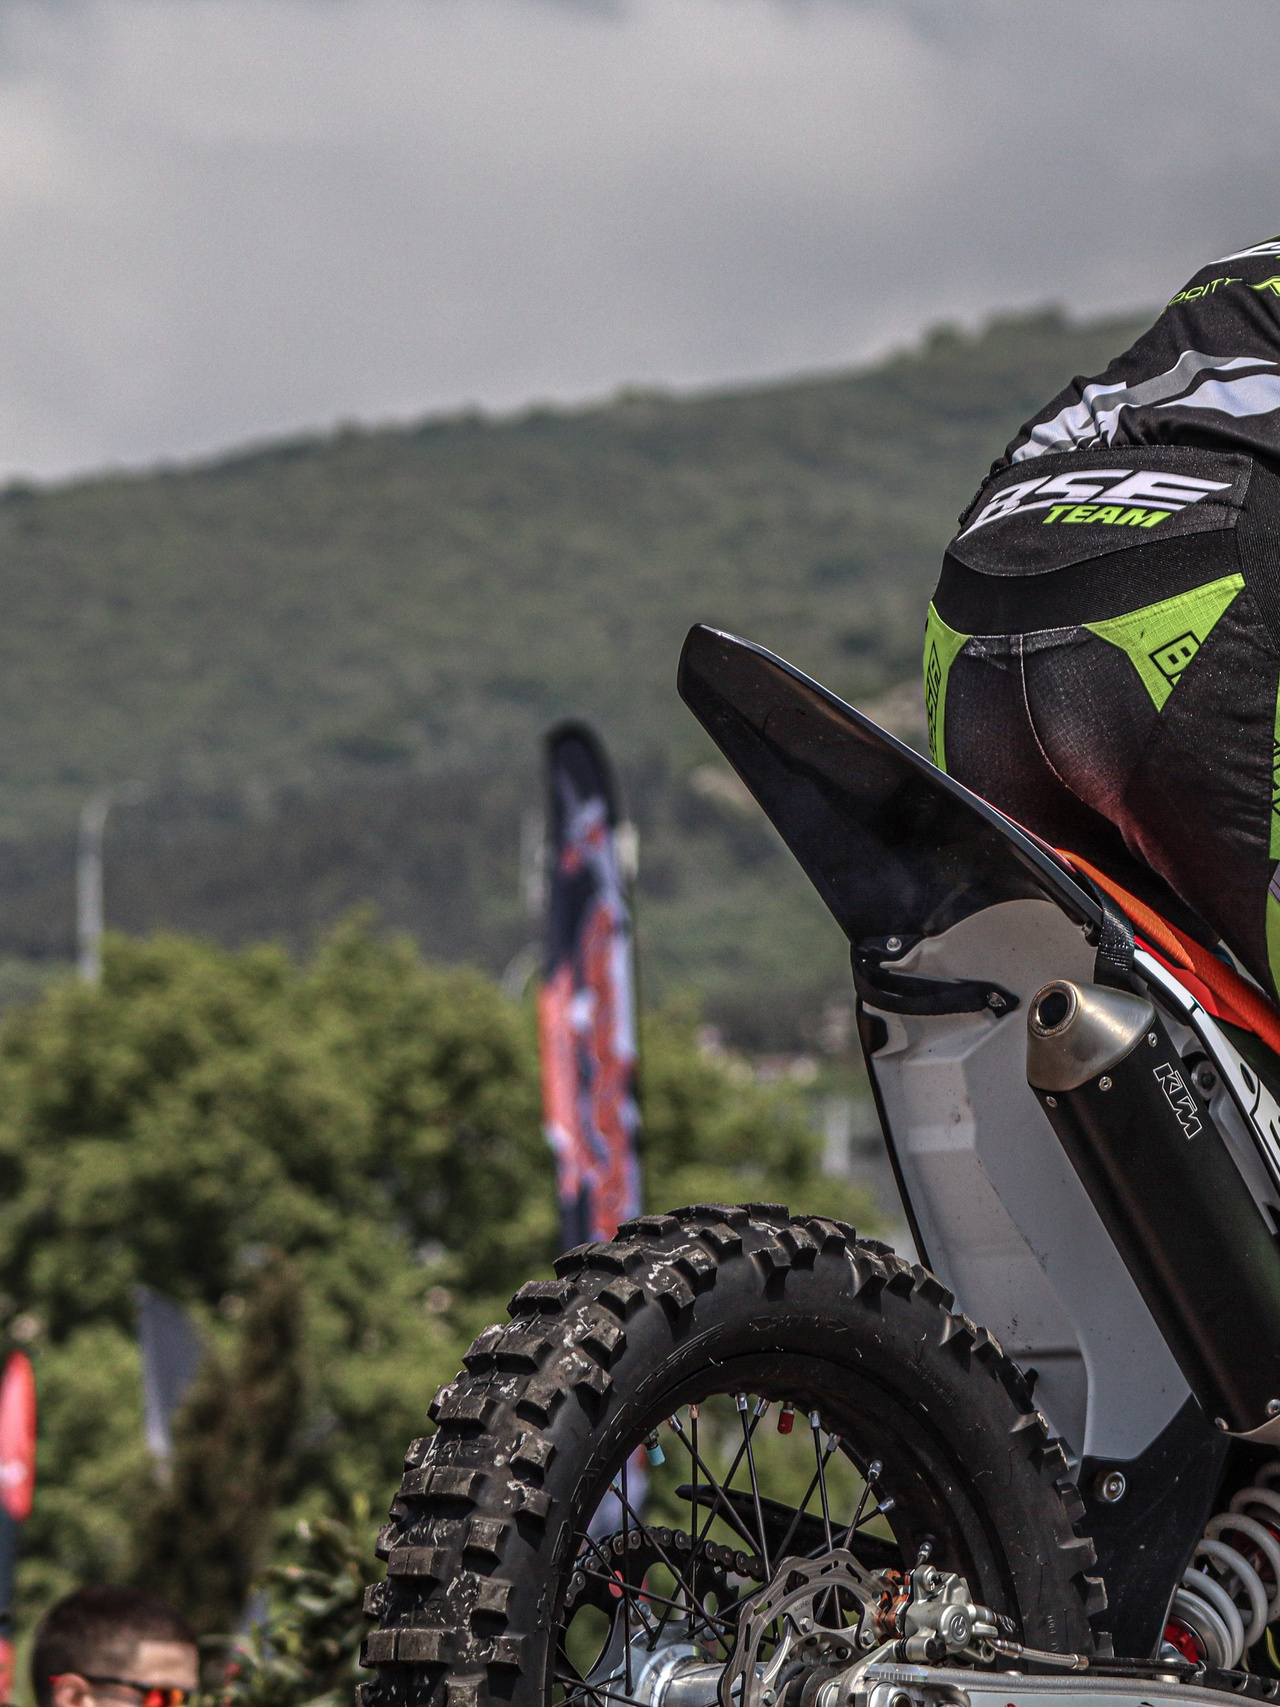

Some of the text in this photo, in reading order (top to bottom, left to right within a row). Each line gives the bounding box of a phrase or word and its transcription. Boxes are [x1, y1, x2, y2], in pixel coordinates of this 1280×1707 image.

[1160, 277, 1244, 315] OCITY
[957, 469, 1233, 541] BSE
[1043, 504, 1172, 528] TEAM
[1153, 1062, 1203, 1140] KTM
